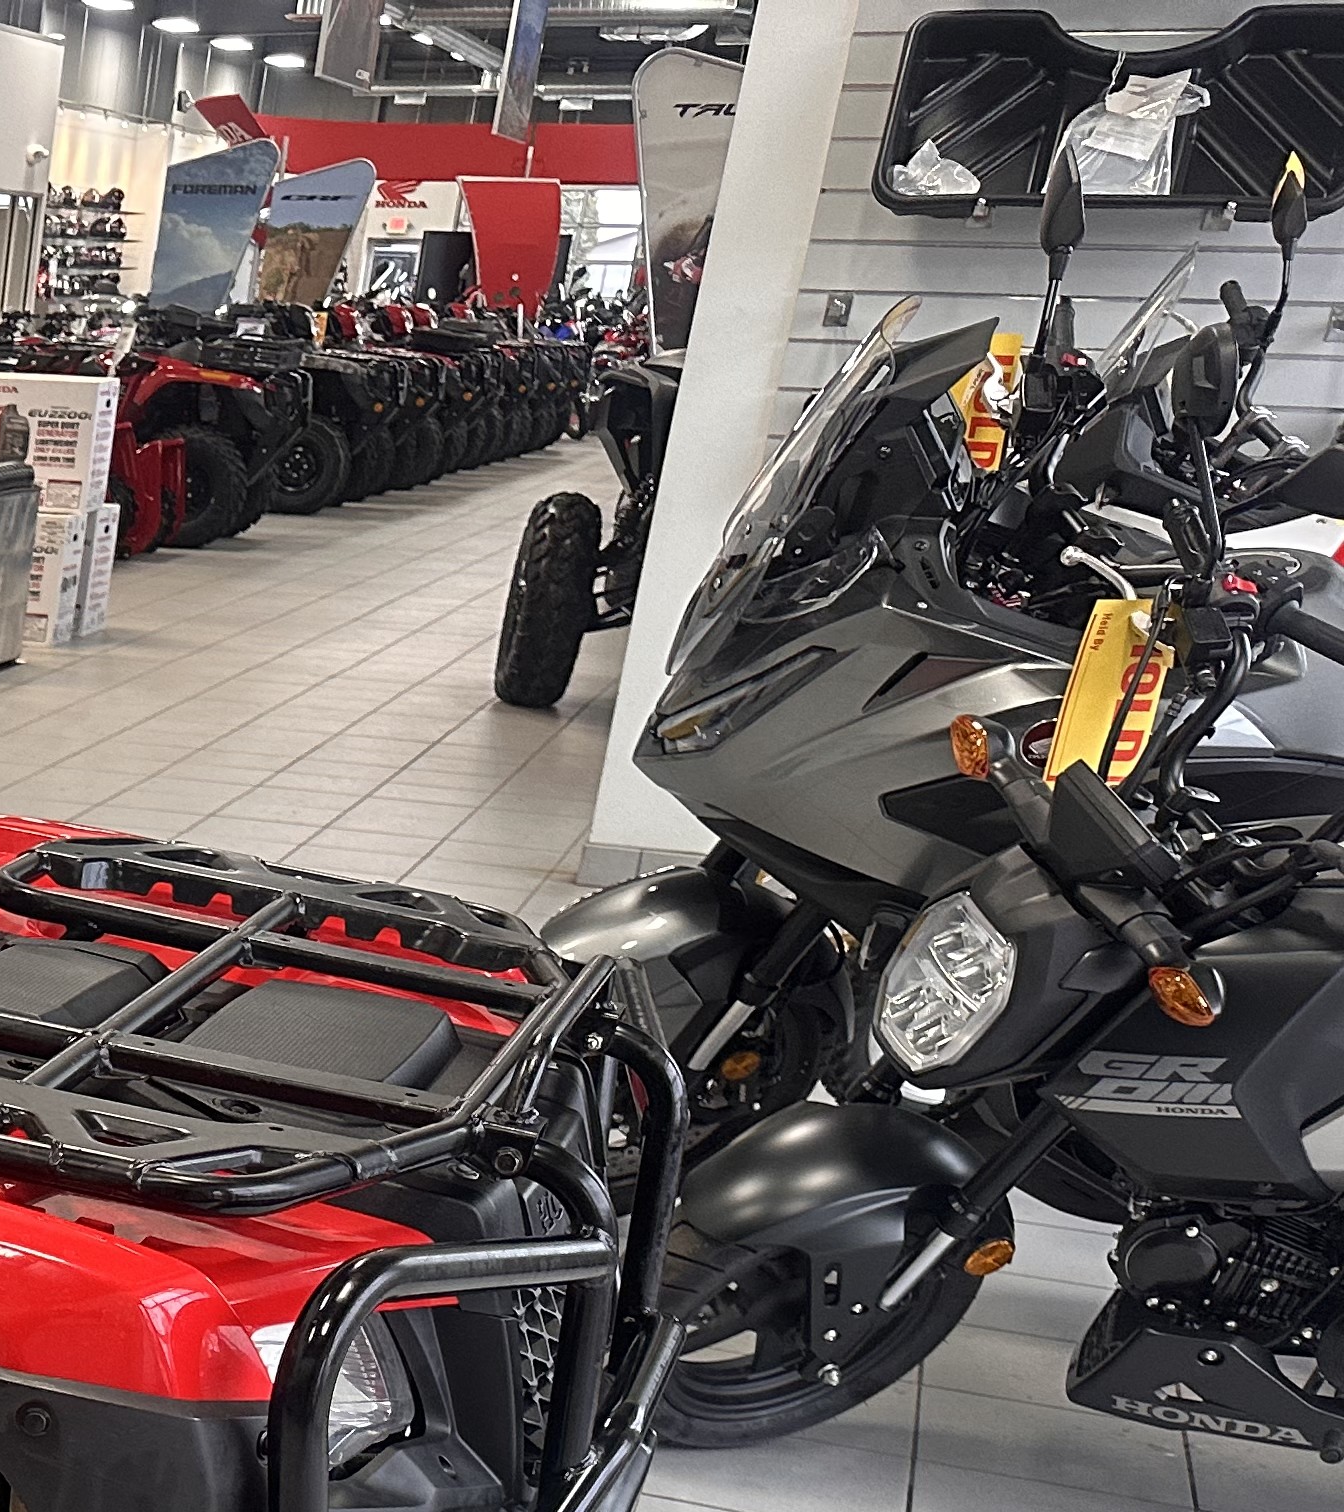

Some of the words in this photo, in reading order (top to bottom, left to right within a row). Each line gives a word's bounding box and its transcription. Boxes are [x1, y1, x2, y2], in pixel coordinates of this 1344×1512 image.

[172, 184, 257, 195] FOREMAN
[375, 200, 427, 209] HONDA
[1089, 637, 1103, 652] By
[1156, 1105, 1228, 1115] HONDA
[1112, 1397, 1312, 1446] HONDA
